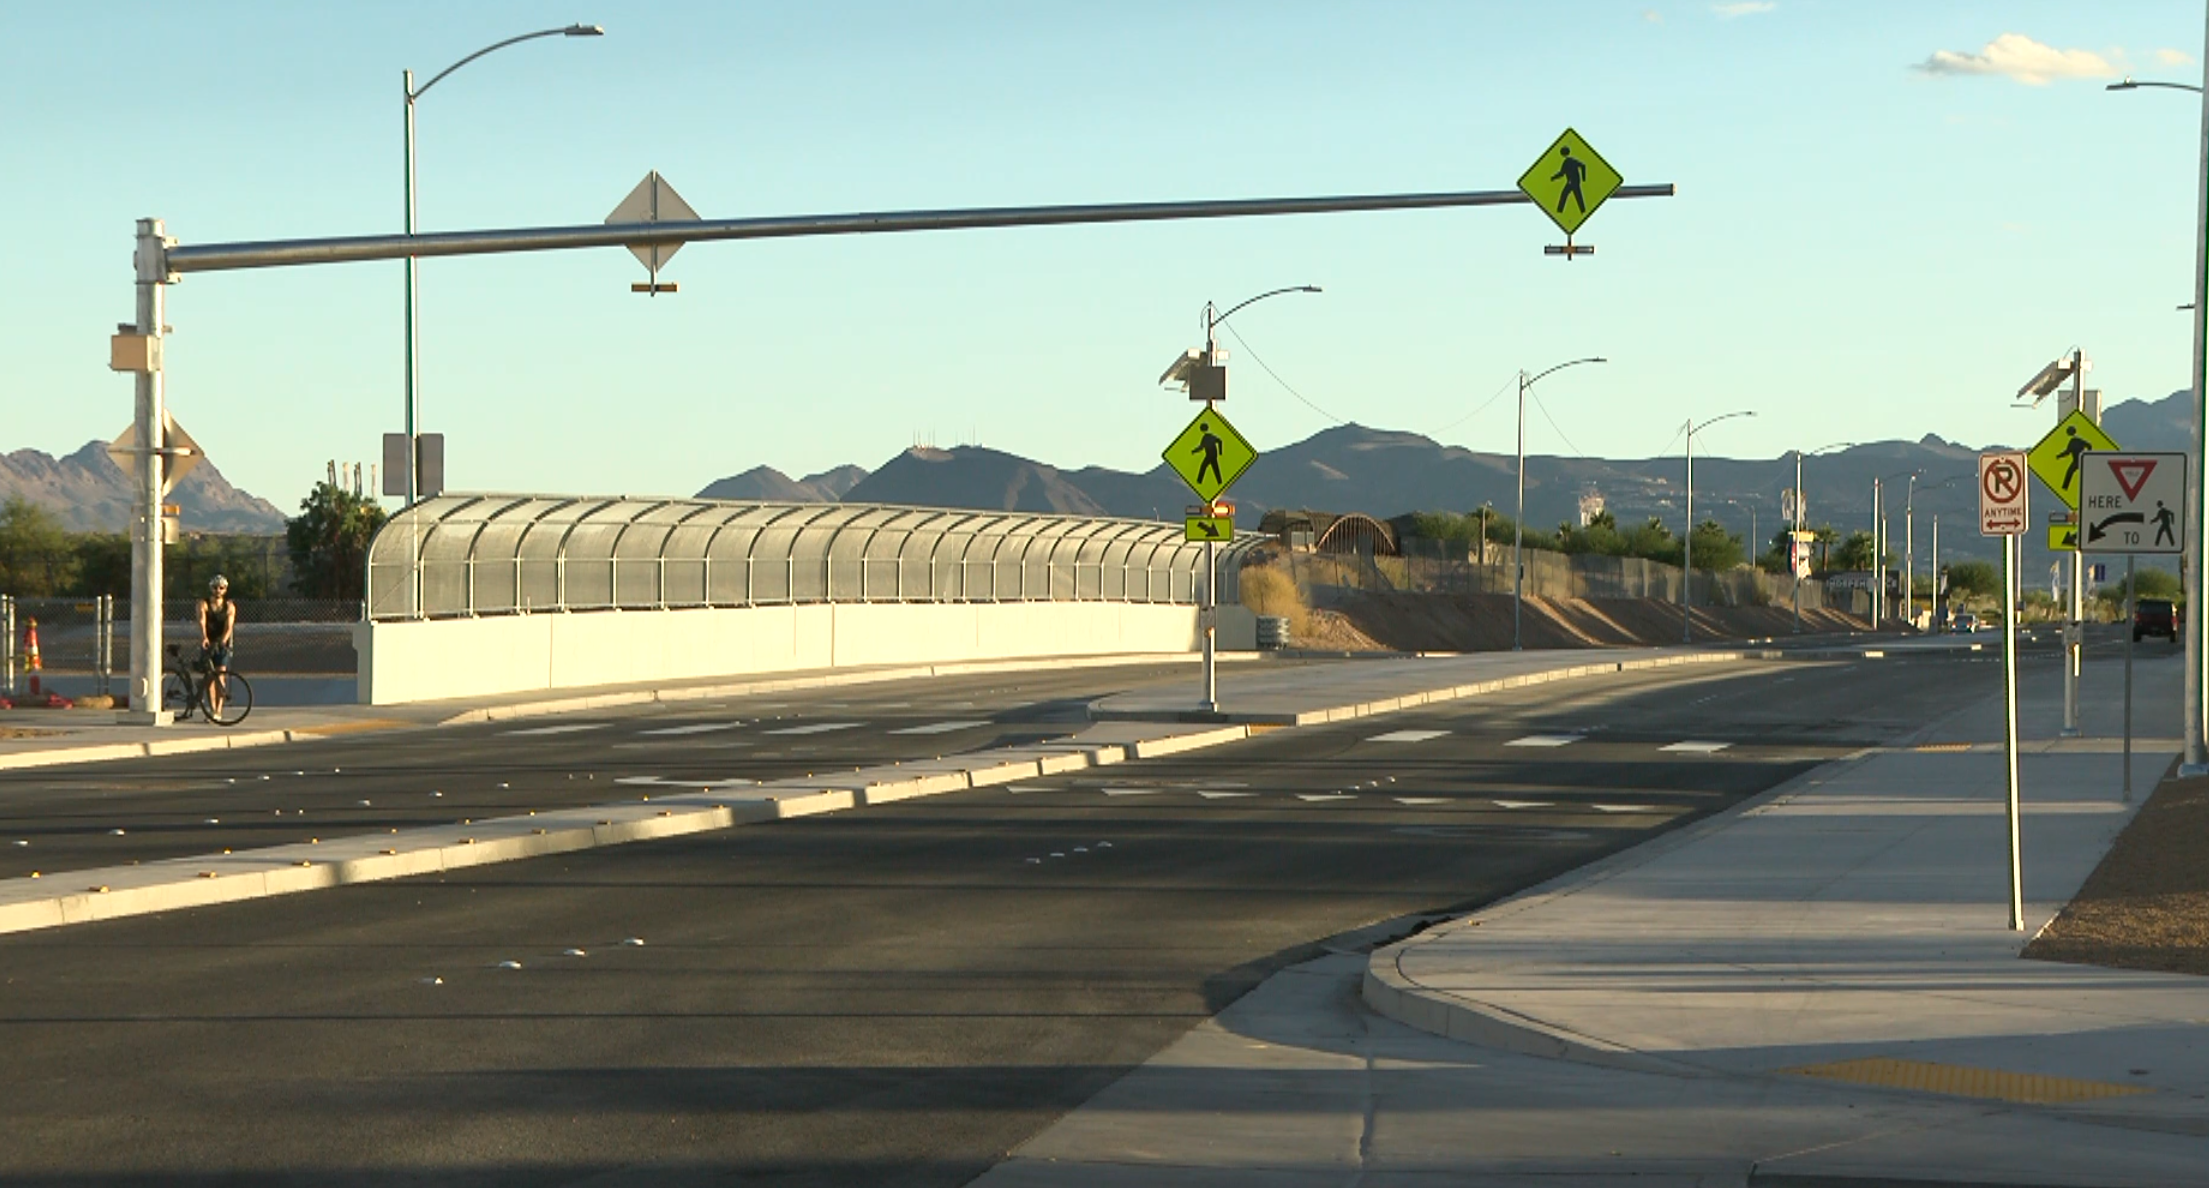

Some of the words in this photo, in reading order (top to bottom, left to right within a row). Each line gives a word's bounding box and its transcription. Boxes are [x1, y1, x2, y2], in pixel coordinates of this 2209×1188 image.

[2088, 495, 2122, 508] HERE
[1984, 507, 2022, 518] ANYTIME
[2124, 531, 2140, 545] TO
